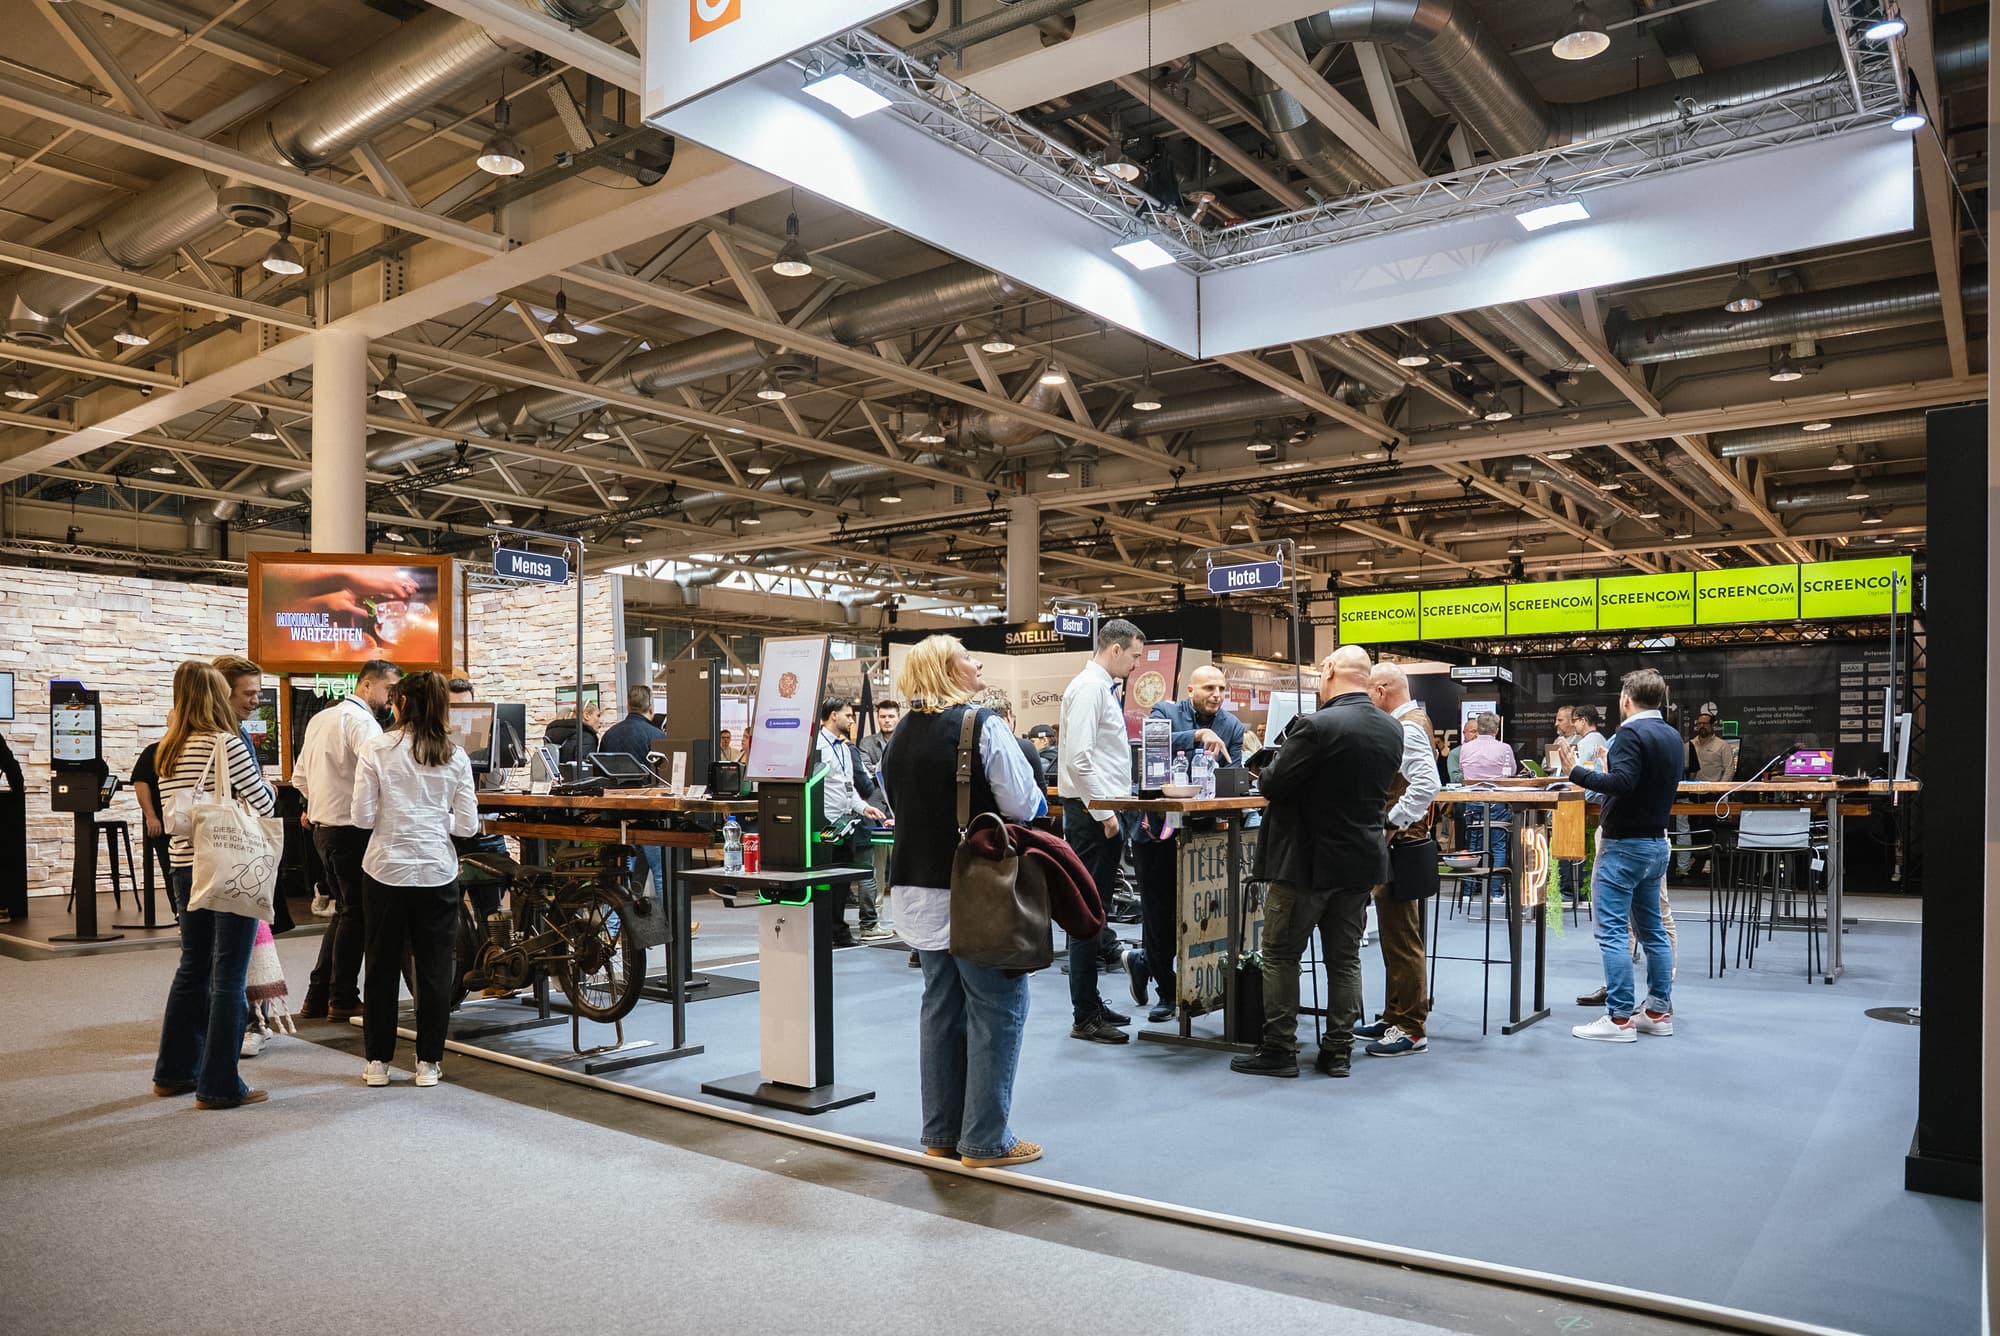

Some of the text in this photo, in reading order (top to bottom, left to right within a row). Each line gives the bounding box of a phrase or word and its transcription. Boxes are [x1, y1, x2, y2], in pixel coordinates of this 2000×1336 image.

[511, 555, 552, 577] Mensa
[1227, 567, 1261, 587] Hotel
[1803, 574, 1907, 593] SCREENCOM
[1601, 589, 1690, 606] SCREENCOM
[1699, 581, 1794, 600] SCREENCOM
[1423, 601, 1502, 617] SCREENCOM
[1509, 595, 1593, 612] SCREENCOM
[276, 612, 329, 627] MINIMALE
[1341, 607, 1416, 623] SCREENCOM
[1062, 618, 1083, 632] Bistrot
[290, 627, 363, 642] WARTEZEITEN
[1558, 672, 1592, 687] YBM
[1707, 672, 1720, 680] App
[315, 673, 355, 696] hell
[213, 825, 238, 834] DIESE
